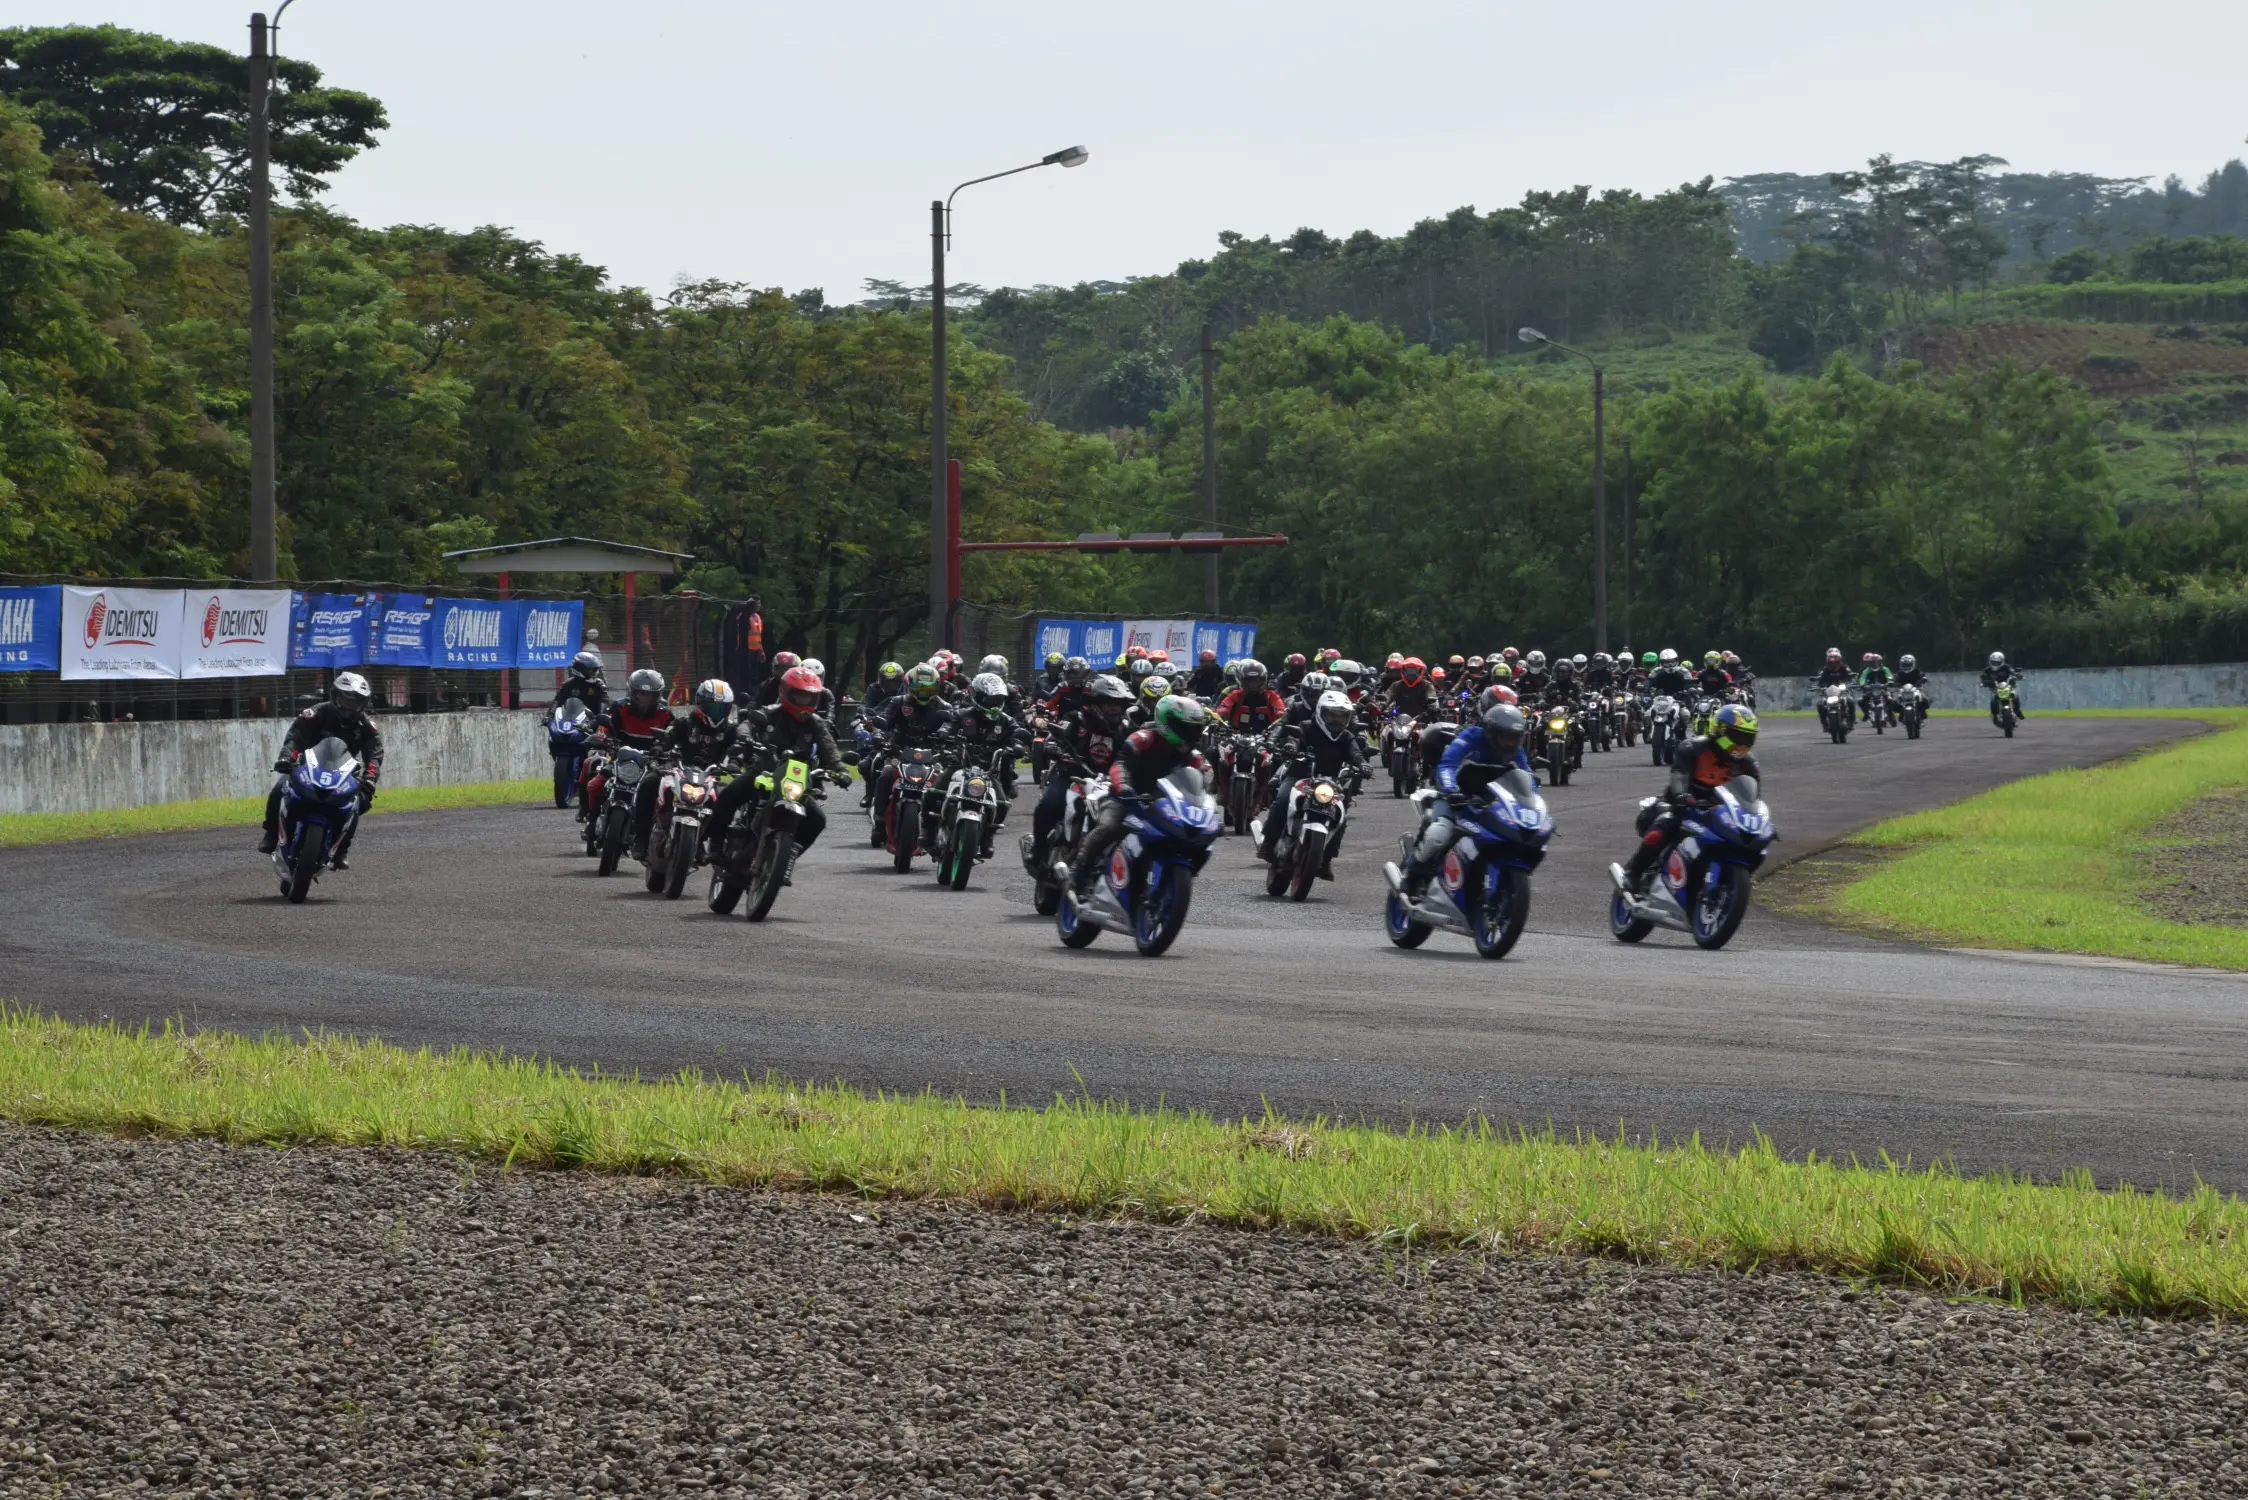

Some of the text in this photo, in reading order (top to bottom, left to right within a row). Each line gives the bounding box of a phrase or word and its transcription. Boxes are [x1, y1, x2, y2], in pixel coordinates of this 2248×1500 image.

[0, 598, 35, 644] AHA
[104, 609, 159, 637] IDEMITSU
[219, 609, 268, 637] IDEMITSU
[458, 609, 501, 647] YAMAHA
[536, 611, 571, 647] YAMAHA
[447, 652, 497, 662] RACING
[528, 651, 566, 661] RACING
[562, 721, 572, 731] 9
[319, 771, 332, 786] 5
